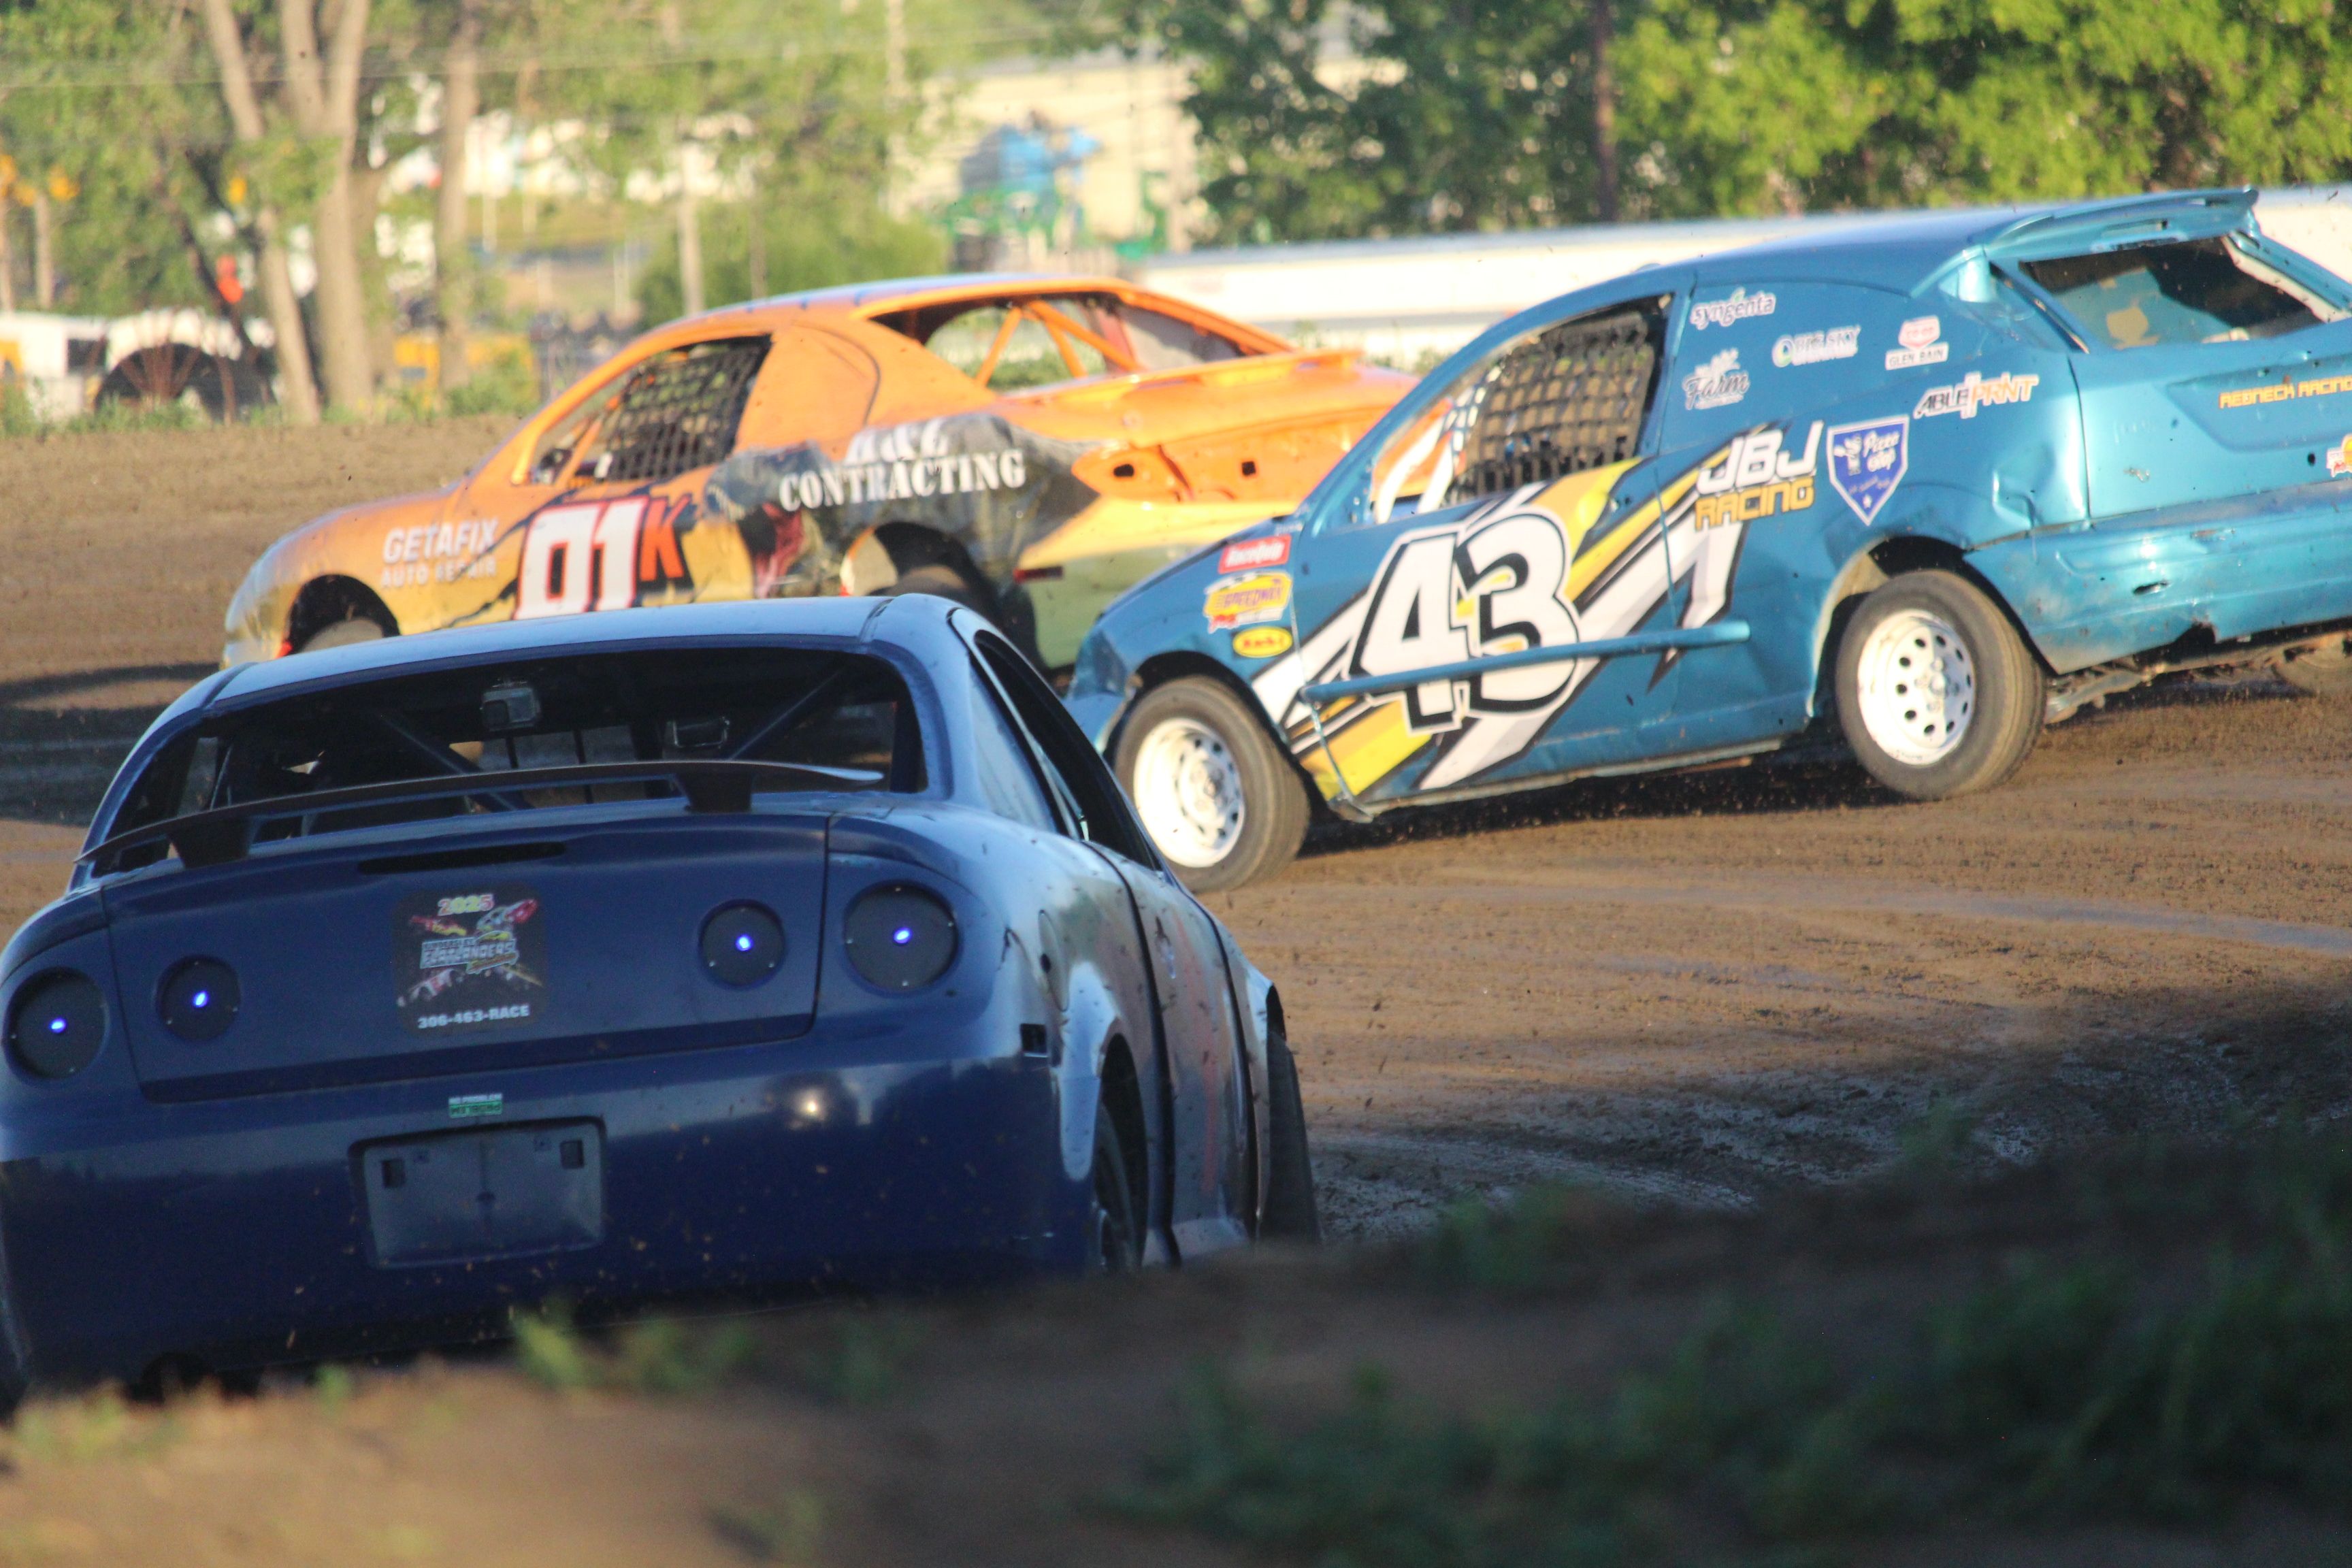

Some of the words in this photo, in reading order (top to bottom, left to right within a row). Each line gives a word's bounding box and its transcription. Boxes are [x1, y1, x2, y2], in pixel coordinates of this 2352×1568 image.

[1692, 290, 1775, 329] syngenta
[1795, 336, 1824, 352] BIG
[1827, 327, 1859, 346] SKY
[1889, 355, 1914, 368] GLEN
[1684, 373, 1749, 410] Farm
[2219, 382, 2295, 409] REDNECK
[1696, 419, 1824, 495] JBJ
[779, 447, 1027, 512] CONTRACTING
[1694, 476, 1815, 533] RACING
[382, 516, 499, 565] GETAFIX
[380, 563, 430, 589] AUTO
[1348, 510, 1580, 734] 43
[438, 894, 495, 916] 2025
[417, 1004, 530, 1029] 306-463-RACE
